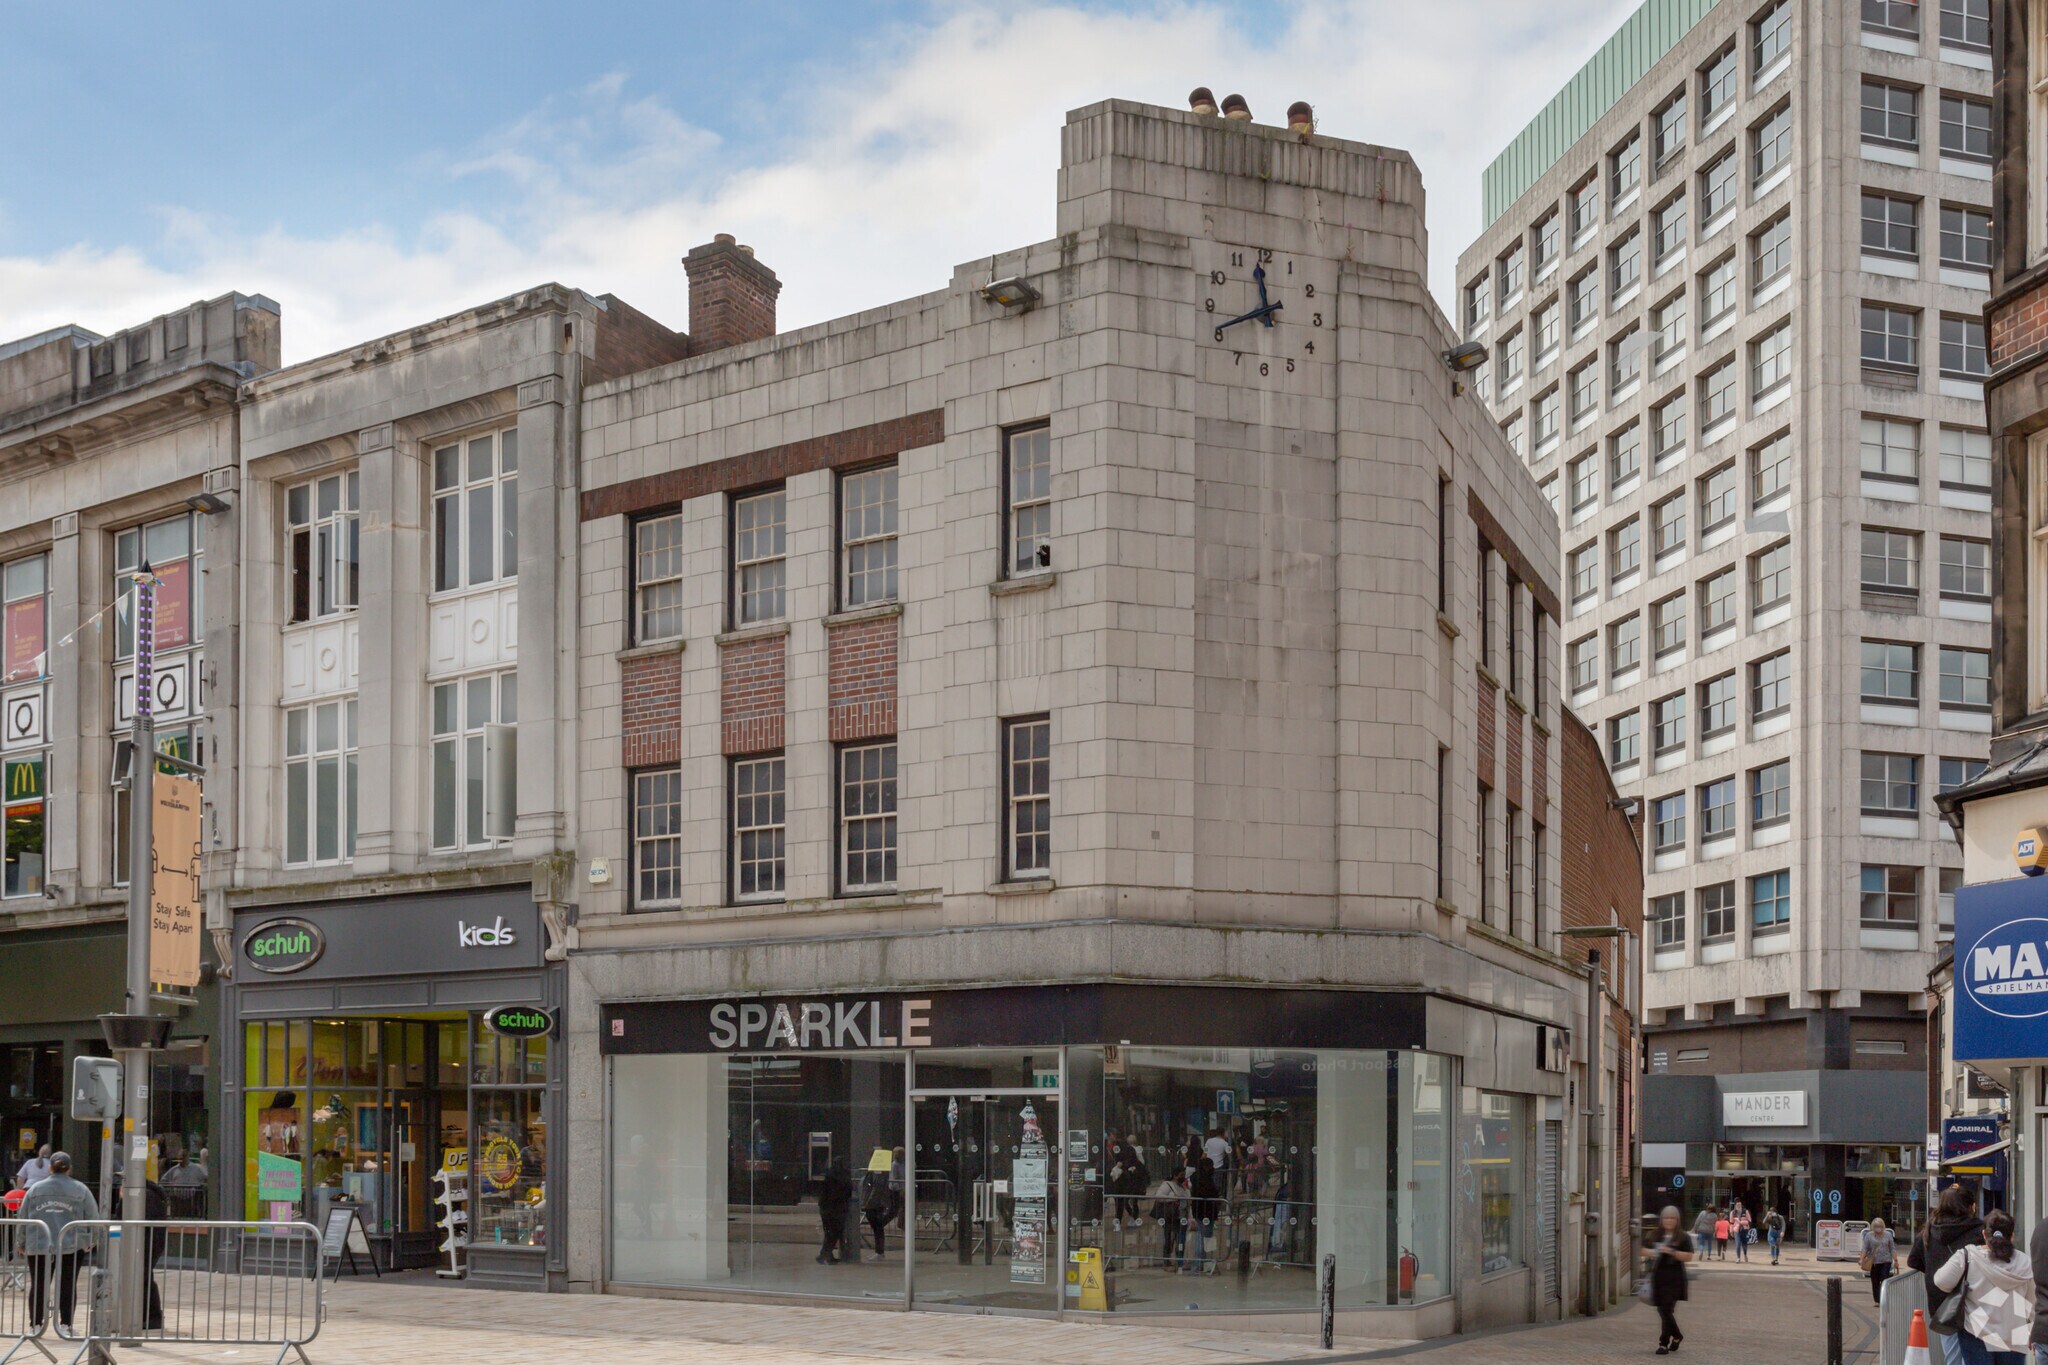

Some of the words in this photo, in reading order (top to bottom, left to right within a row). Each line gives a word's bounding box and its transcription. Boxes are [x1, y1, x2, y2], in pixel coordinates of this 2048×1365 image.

[1231, 252, 1243, 267] 11
[1257, 250, 1272, 263] 12
[1288, 261, 1293, 274] 1
[1211, 271, 1226, 285] 10
[1305, 284, 1315, 298] 2
[1205, 298, 1215, 312] 9
[1313, 313, 1322, 327] 3
[1214, 327, 1224, 342] 8
[1305, 341, 1315, 354] 4
[1233, 352, 1242, 365] 7
[1286, 359, 1295, 372] 5
[1259, 363, 1269, 376] 6
[2018, 843, 2034, 853] ADT
[156, 902, 172, 918] Stay
[176, 905, 191, 918] Safe
[153, 918, 170, 934] Stay
[458, 915, 515, 947] kids
[253, 931, 311, 957] schuh
[1974, 942, 2048, 982] MA
[498, 1011, 546, 1029] schuh
[709, 1000, 932, 1049] SPARKLE
[1735, 1096, 1790, 1111] MANDER
[1750, 1115, 1775, 1123] CENTRE
[1949, 1125, 1993, 1133] ADMIRAL
